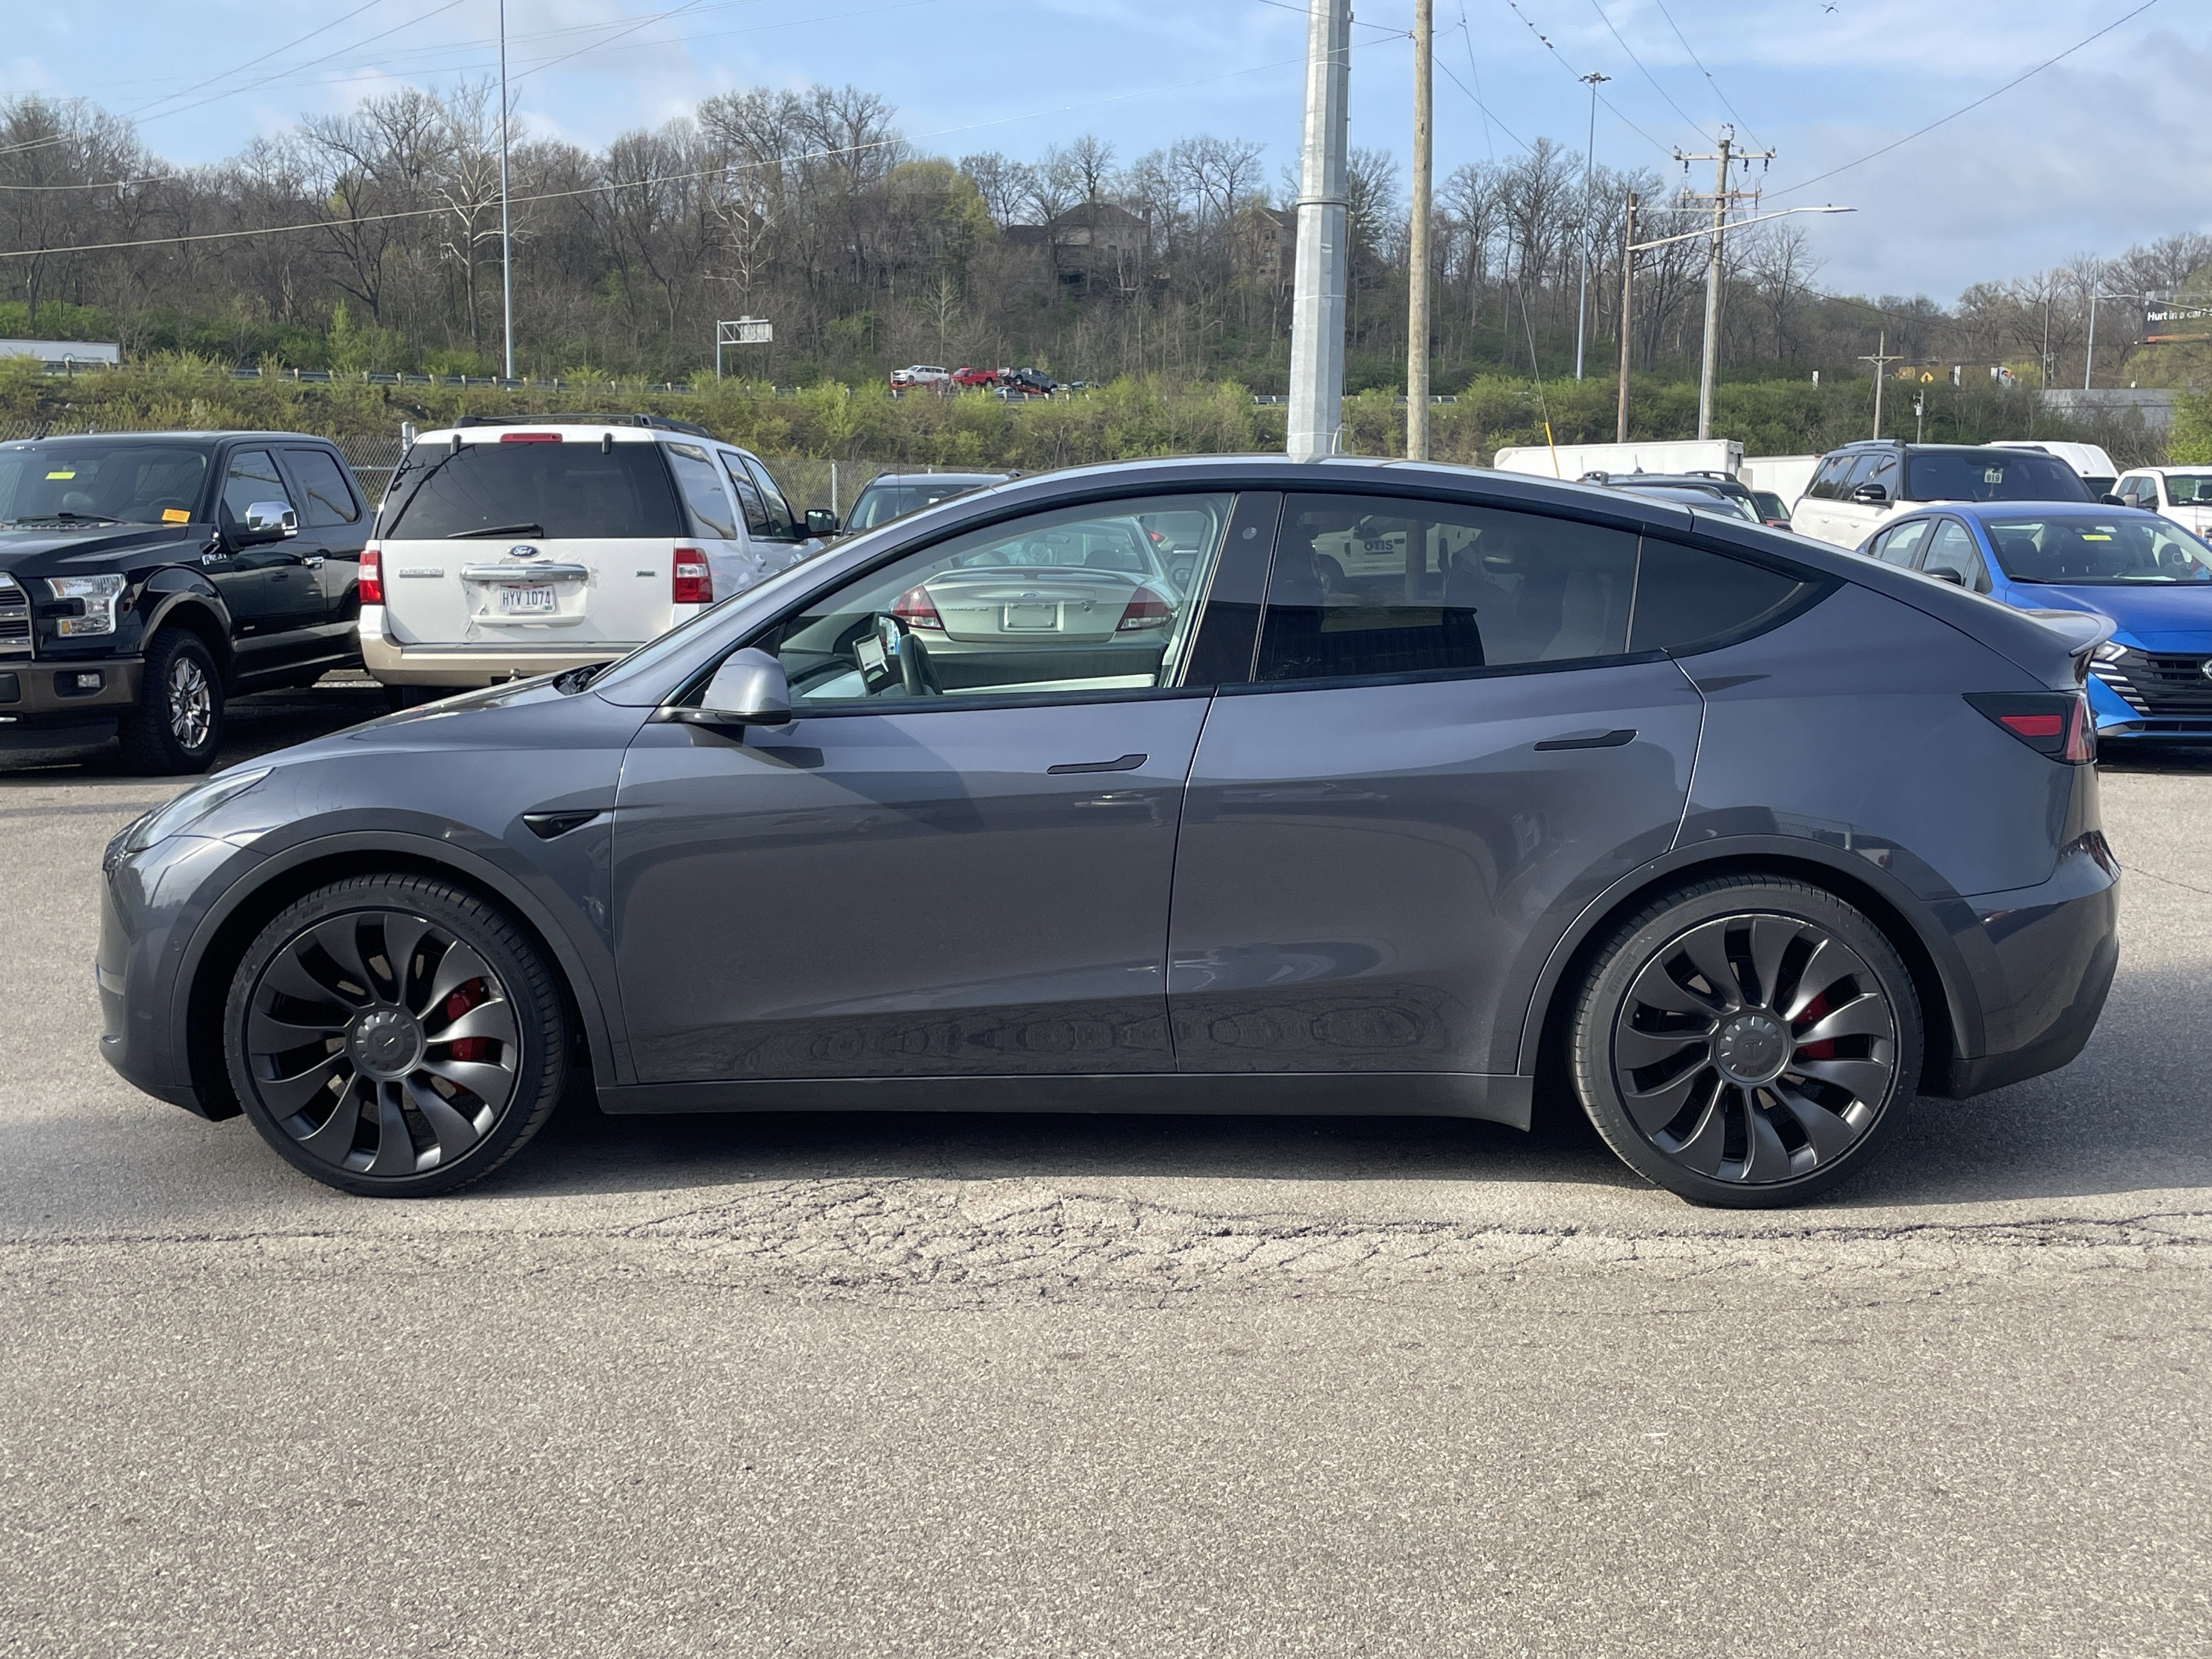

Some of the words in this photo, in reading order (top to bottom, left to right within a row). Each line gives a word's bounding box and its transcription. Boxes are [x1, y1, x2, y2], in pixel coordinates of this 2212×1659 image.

[2147, 311, 2168, 321] Hurt
[2169, 310, 2177, 320] in
[1987, 473, 2000, 482] 919
[1364, 540, 1393, 551] OTIS
[503, 591, 522, 605] HYV
[526, 591, 550, 605] 1074
